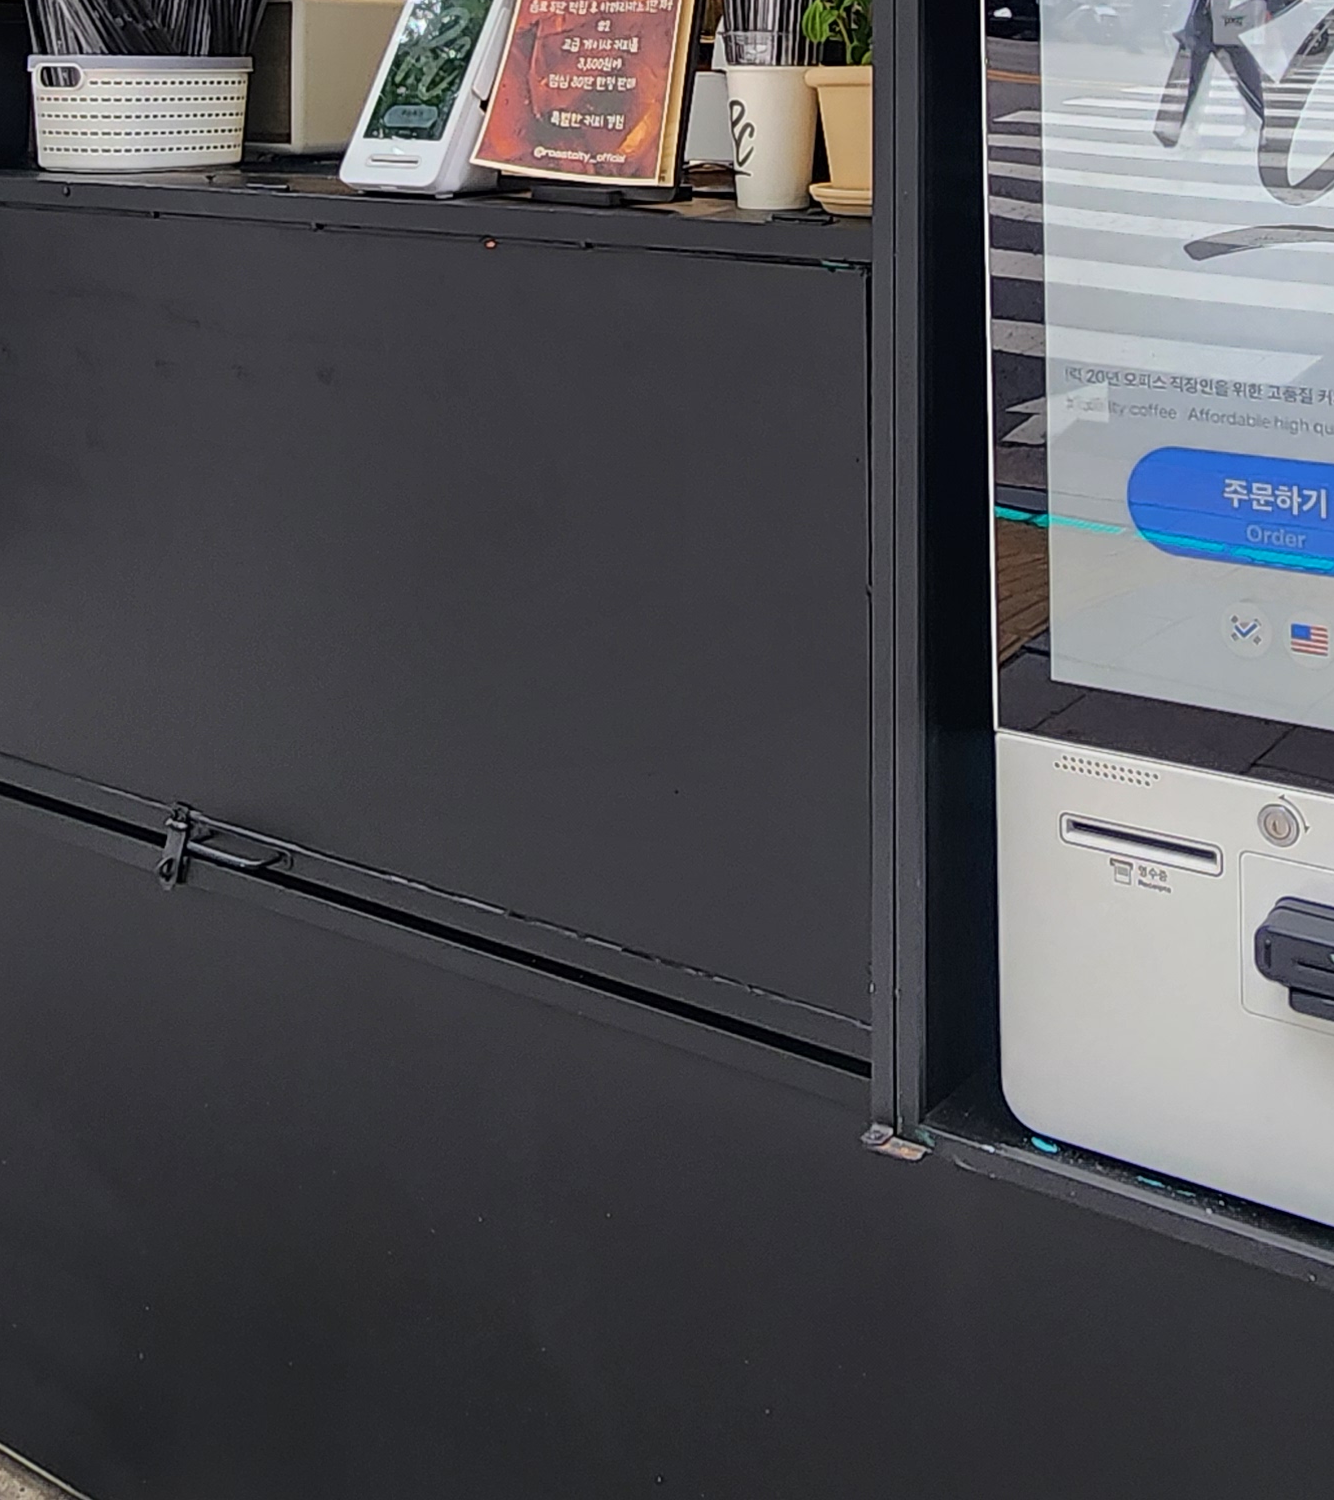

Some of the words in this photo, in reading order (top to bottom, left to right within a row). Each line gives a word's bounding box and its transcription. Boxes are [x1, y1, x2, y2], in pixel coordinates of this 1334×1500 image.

[1065, 368, 1082, 384] 력
[1085, 369, 1120, 387] 20년
[1123, 372, 1167, 390] 오피스
[1169, 376, 1229, 398] 직장인을
[1232, 381, 1264, 400] 위한
[1267, 384, 1313, 405] 고품질
[1130, 402, 1178, 420] coffee
[1187, 409, 1270, 431] Affordable
[1273, 414, 1310, 436] high
[1223, 478, 1329, 519] 주문하기
[1245, 523, 1307, 551] Order
